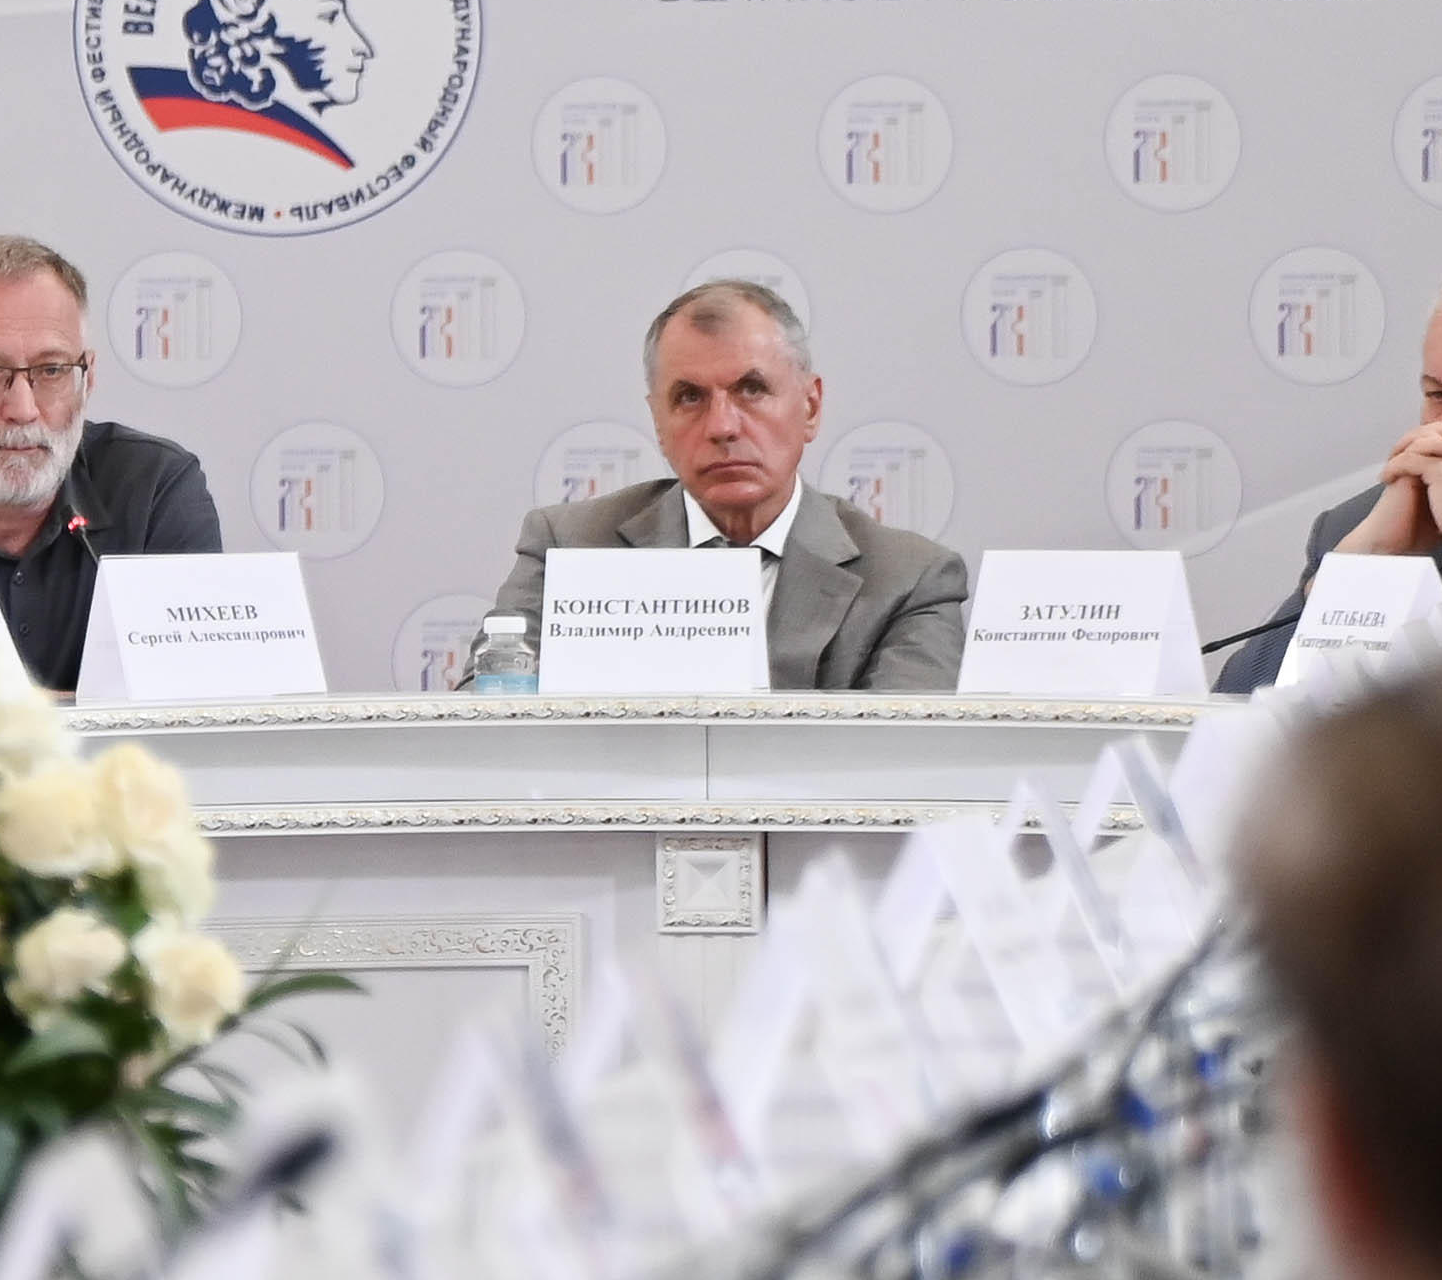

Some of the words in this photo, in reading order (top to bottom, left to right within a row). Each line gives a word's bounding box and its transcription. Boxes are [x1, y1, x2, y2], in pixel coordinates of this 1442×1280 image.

[95, 88, 265, 222] МЕЖДУНАРОДНЫЙ
[290, 150, 417, 222] ФЕСТИВАЛЬ
[167, 604, 258, 622] МИХЕЕВ
[553, 598, 750, 614] КОНСТАНТИНОВ
[1021, 604, 1122, 621] ЗАТУЛИН
[128, 630, 182, 647] Сергей
[188, 628, 306, 643] Александрович
[549, 623, 644, 640] Владимир
[650, 623, 750, 640] Андреевич
[973, 628, 1066, 643] Константин
